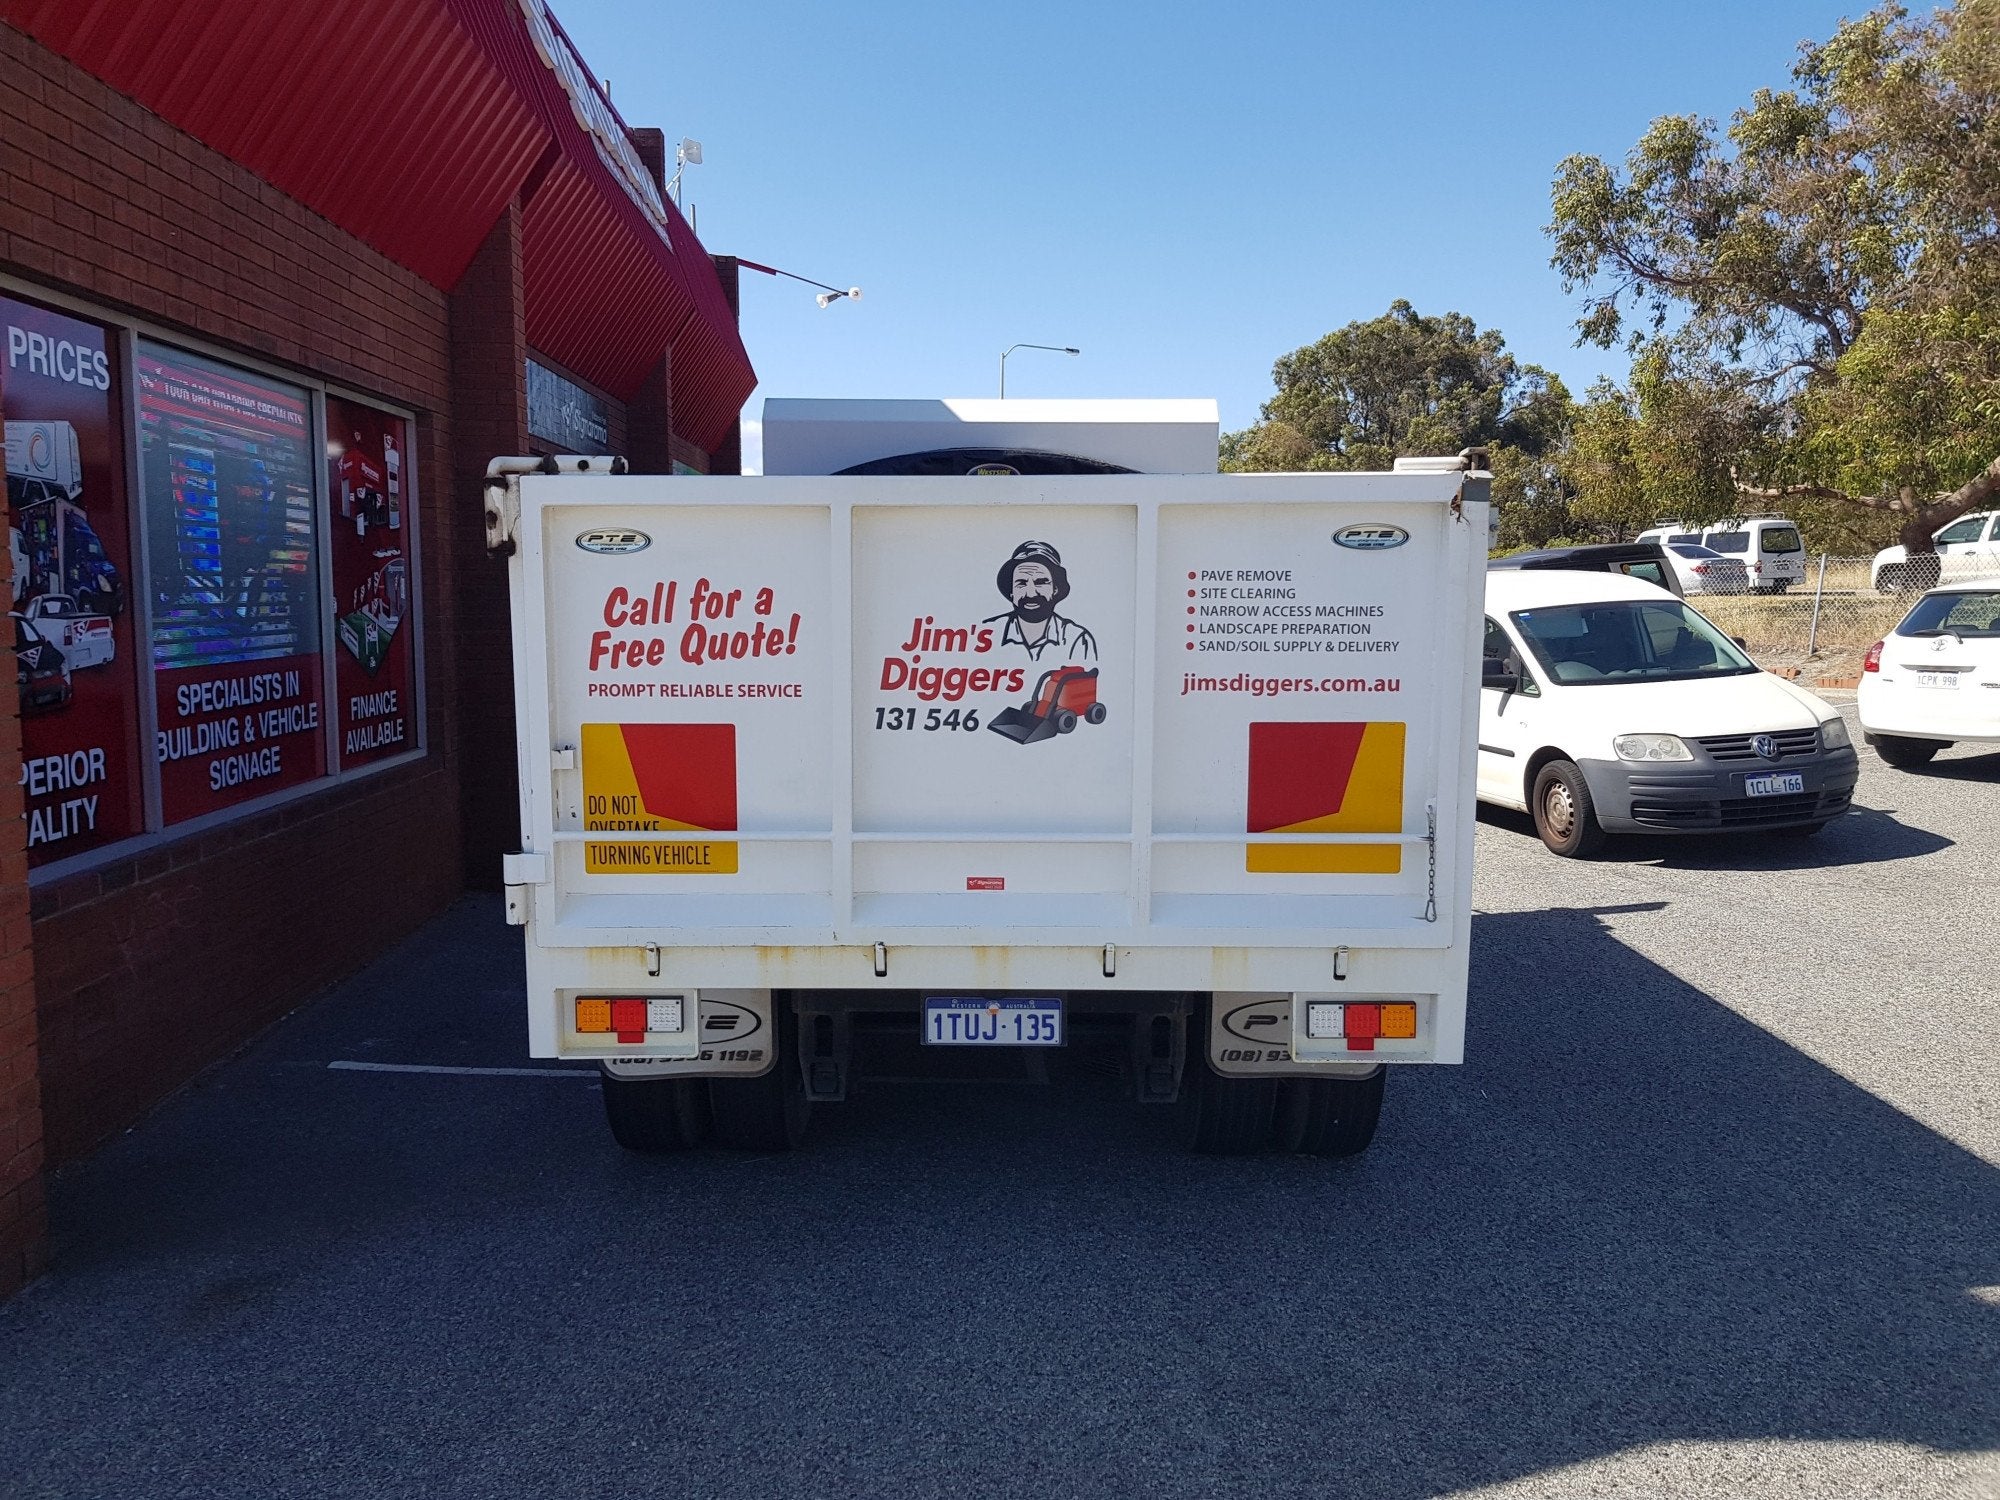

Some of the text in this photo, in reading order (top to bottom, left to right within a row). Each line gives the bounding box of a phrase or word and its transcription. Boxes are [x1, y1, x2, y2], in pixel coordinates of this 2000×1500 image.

[8, 326, 110, 391] PRICES
[587, 534, 637, 543] PTE
[1345, 530, 1396, 539] PTE
[1201, 570, 1292, 582] PAVE REMOVE
[603, 578, 774, 628] Call for a
[1200, 588, 1297, 600] SITE CLEARING
[1200, 605, 1384, 617] NARROW ACCESS MACHINES
[901, 616, 993, 653] Jim's
[1199, 623, 1371, 635] LANDSCAPE PREPARATION
[589, 613, 802, 671] Free Quote!
[1198, 640, 1400, 652] SAND/SOIL SUPPLY & DELIVERY
[880, 655, 1025, 702] Diggers
[1180, 673, 1401, 697] jimsdiggers.com.au
[177, 670, 300, 716] SPECIALISTS IN
[588, 684, 802, 698] PROMPT RELIABLE SERVICE
[351, 690, 398, 721] FINANCE
[875, 707, 980, 732] 131 546
[157, 702, 318, 763] BUILDING & VEHICLE
[345, 718, 404, 755] AVAILABLE
[210, 745, 281, 791] SIGNAGE
[588, 795, 638, 815] DO NOT
[21, 796, 98, 847] ALITY
[590, 845, 711, 865] TURNING VEHICLE
[719, 1050, 763, 1062] 1192
[1220, 1049, 1262, 1062] (08)
